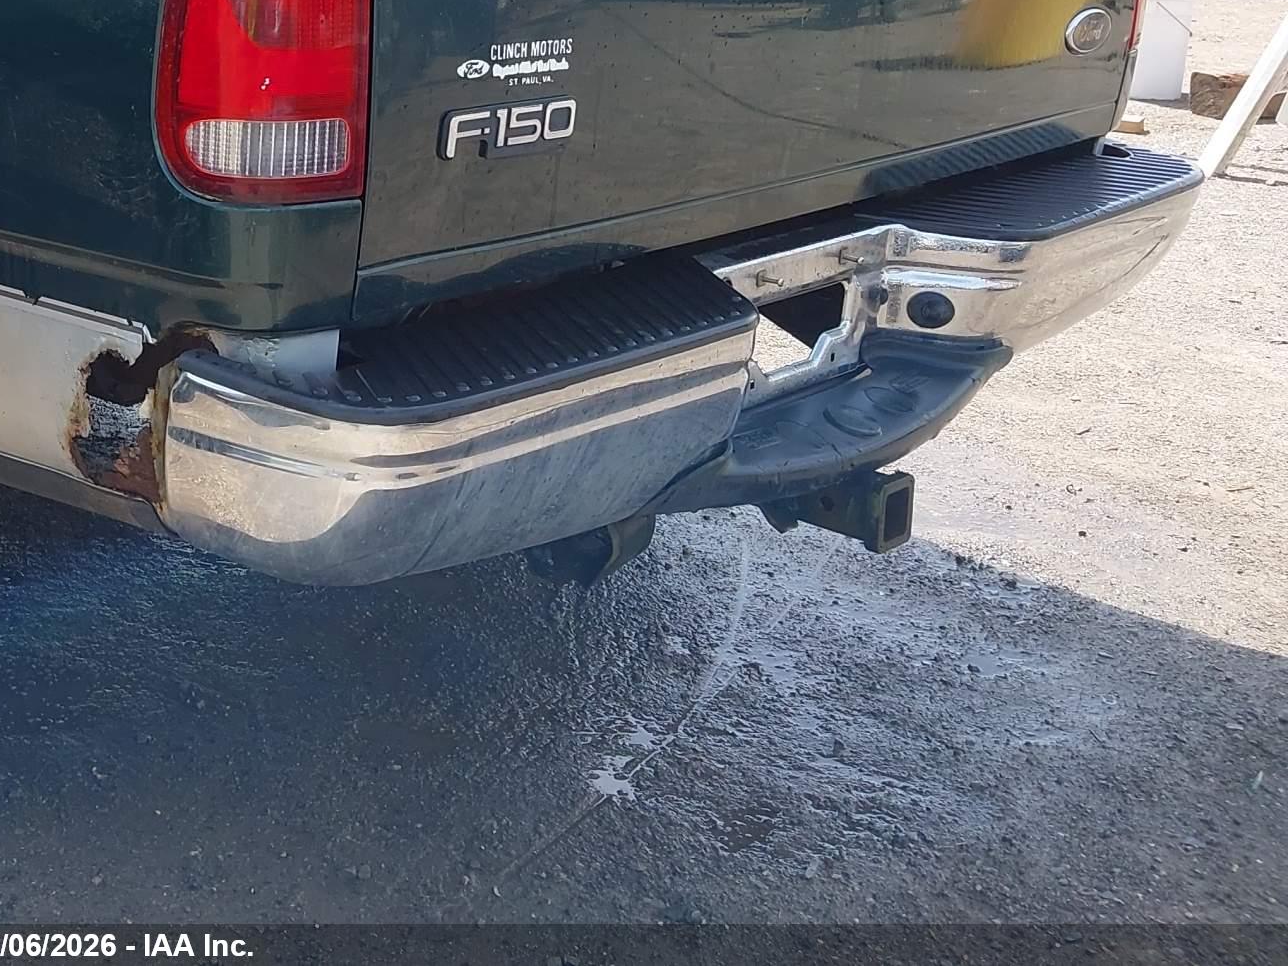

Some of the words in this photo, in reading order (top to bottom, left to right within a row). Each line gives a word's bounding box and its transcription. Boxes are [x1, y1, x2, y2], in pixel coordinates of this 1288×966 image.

[490, 41, 528, 61] CLINCH
[530, 38, 573, 57] MOTORS
[508, 78, 518, 86] ST
[445, 99, 577, 159] F-150
